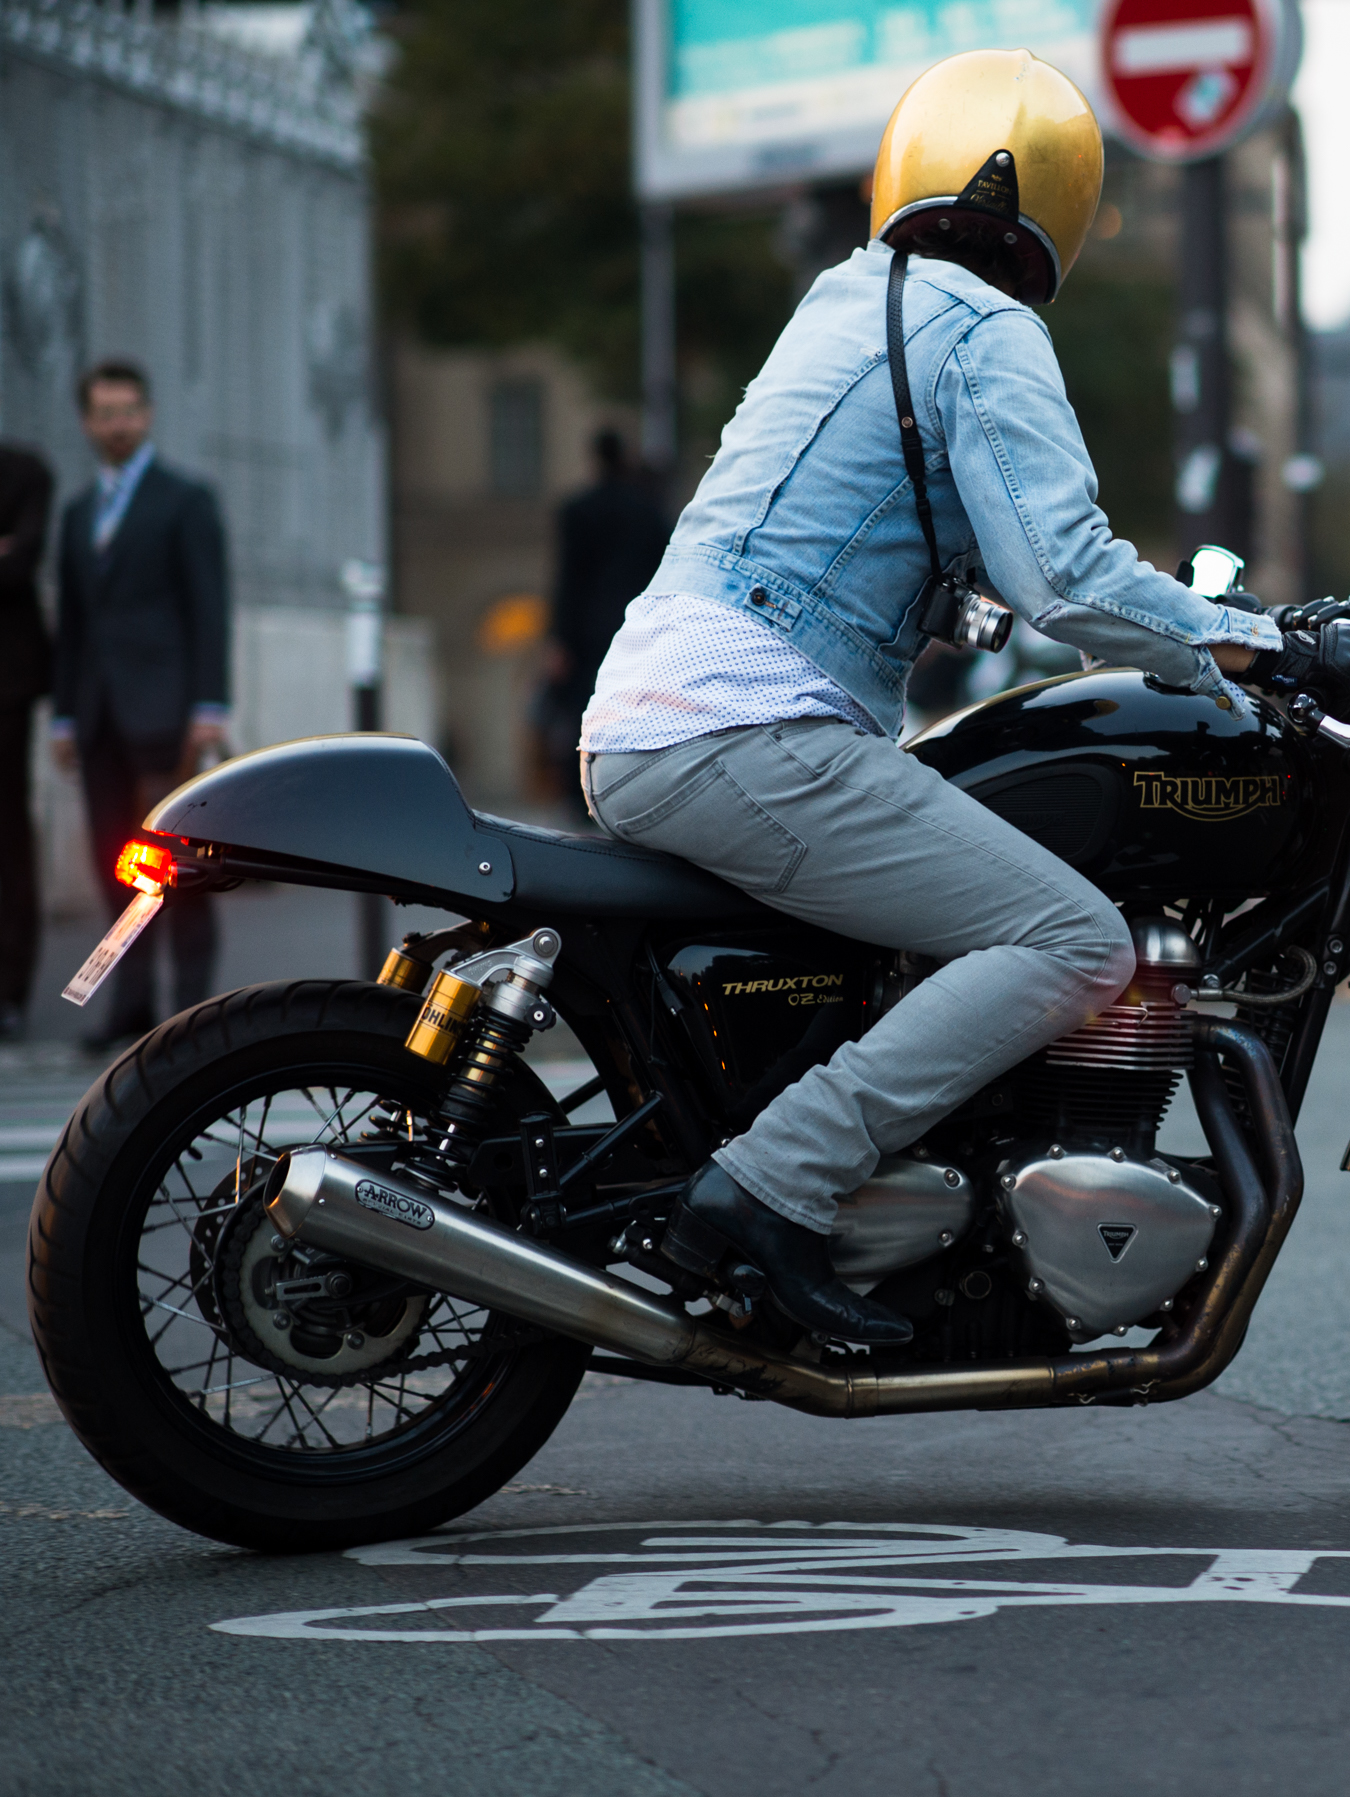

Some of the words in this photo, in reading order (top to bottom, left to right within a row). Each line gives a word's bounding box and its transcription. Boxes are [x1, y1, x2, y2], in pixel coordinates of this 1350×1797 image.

[1133, 771, 1281, 822] TRIUMPH
[721, 973, 844, 996] THRUXTON
[788, 993, 816, 1006] OZ
[816, 994, 844, 1004] Edition
[421, 1001, 464, 1038] ÖHLIN
[363, 1184, 428, 1219] ARROW
[1102, 1230, 1129, 1240] TRIUMPH
